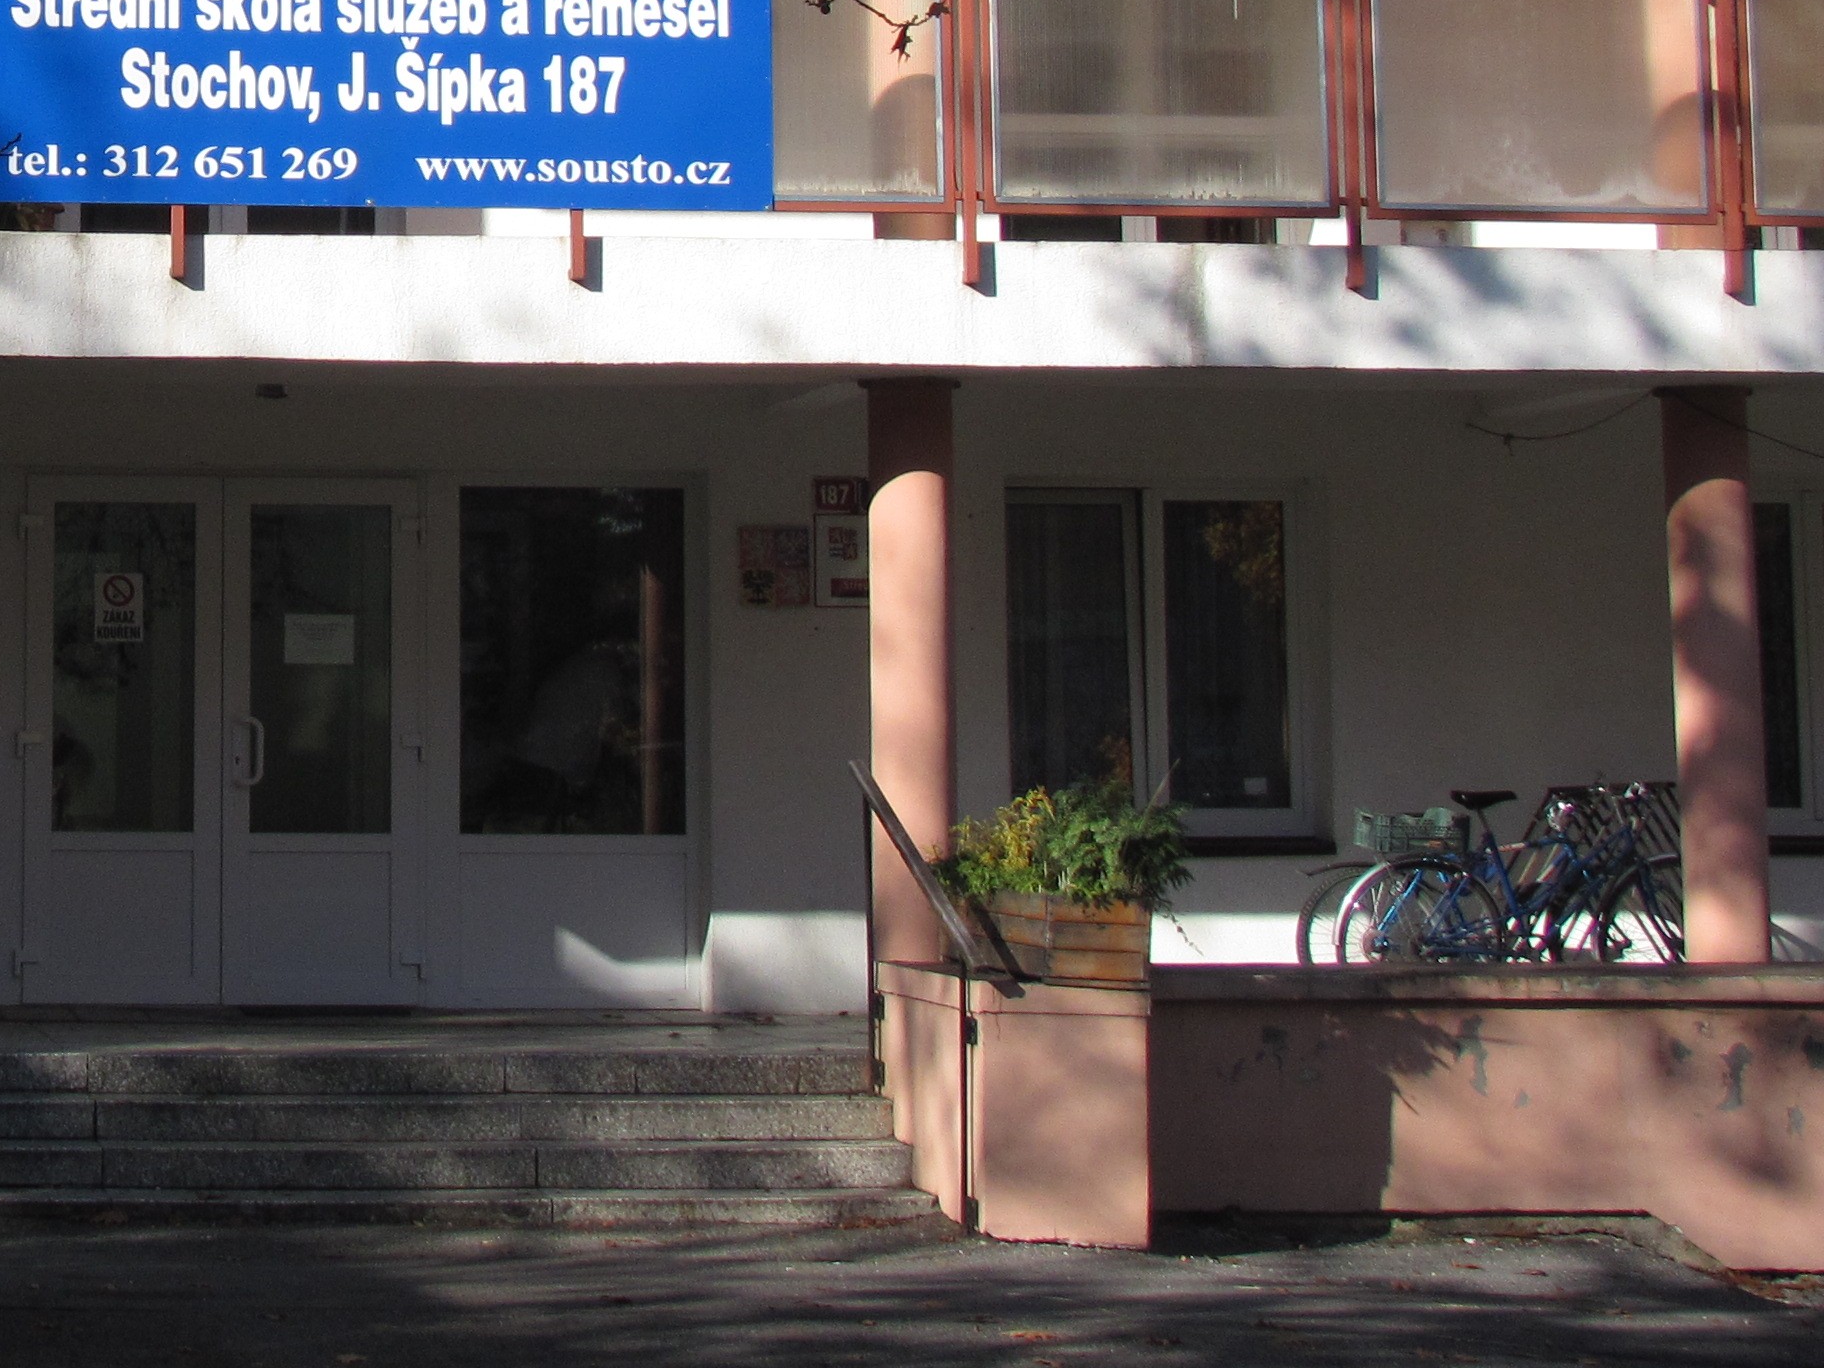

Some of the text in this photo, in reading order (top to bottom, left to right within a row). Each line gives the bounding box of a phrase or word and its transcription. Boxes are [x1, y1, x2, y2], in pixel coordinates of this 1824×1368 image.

[120, 35, 626, 126] Stochov, J. Šípka 187
[8, 144, 358, 180] tel.: 312 651 269
[416, 153, 731, 185] www.sousto.cz
[821, 484, 849, 505] 187
